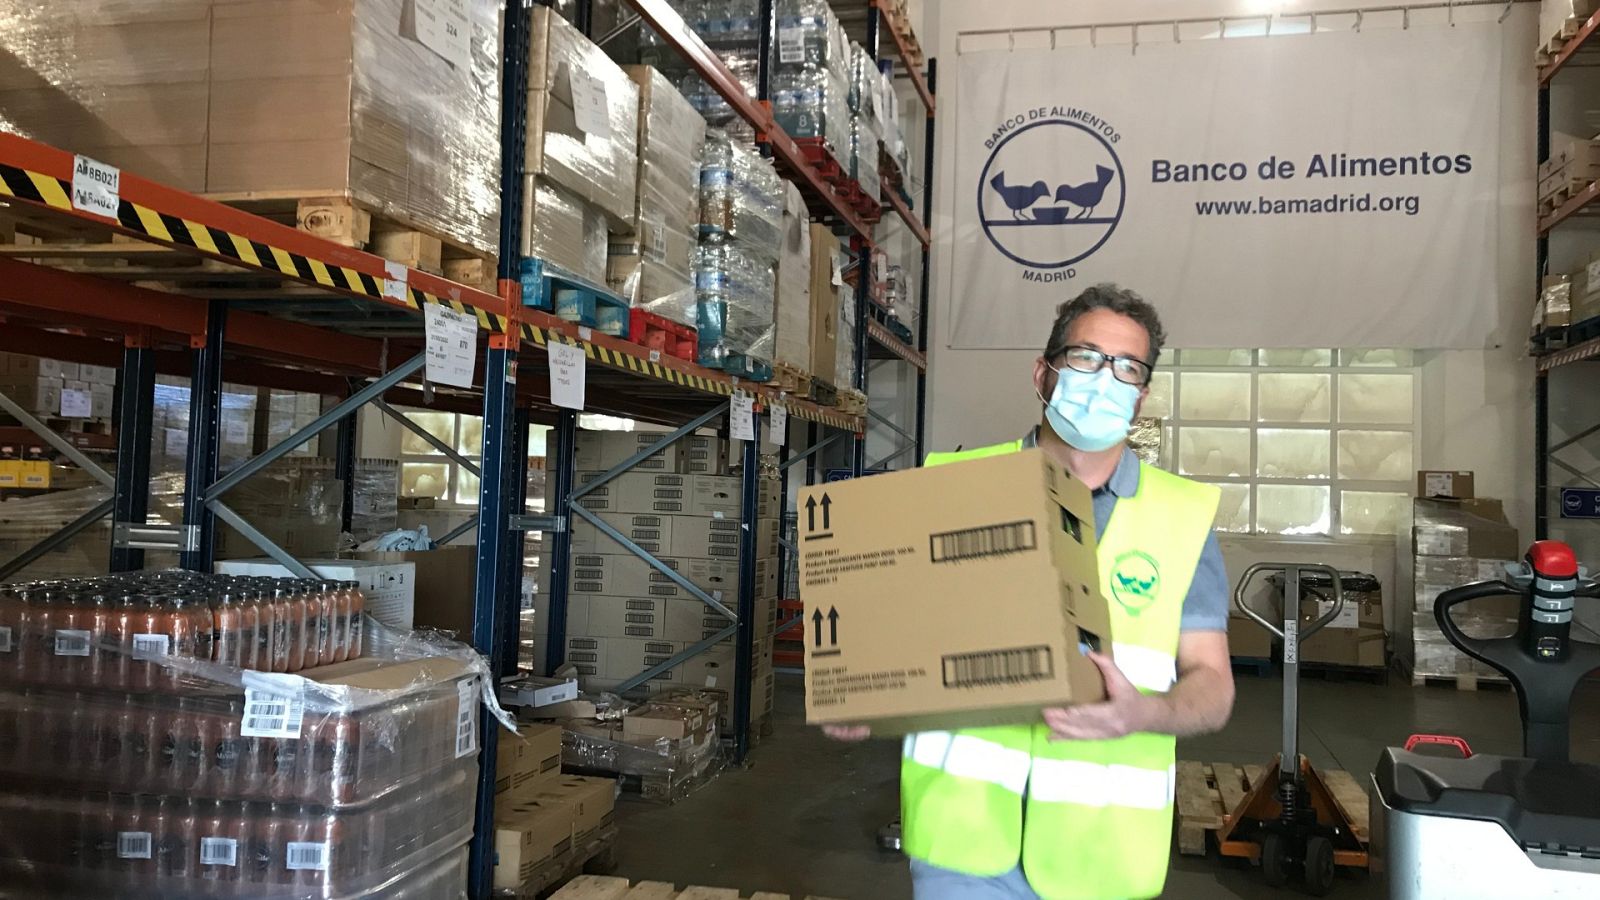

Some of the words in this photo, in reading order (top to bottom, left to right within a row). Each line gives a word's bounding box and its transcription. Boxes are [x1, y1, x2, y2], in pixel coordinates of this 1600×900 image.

[984, 114, 1025, 150] BANCO
[1028, 107, 1047, 121] DE
[1050, 106, 1121, 145] ALIMENTOS
[1151, 159, 1247, 183] Banco
[1257, 155, 1296, 180] de
[1305, 151, 1473, 178] Alimentos
[1195, 192, 1420, 216] www.bamadrid.org
[1022, 267, 1077, 283] MADRID
